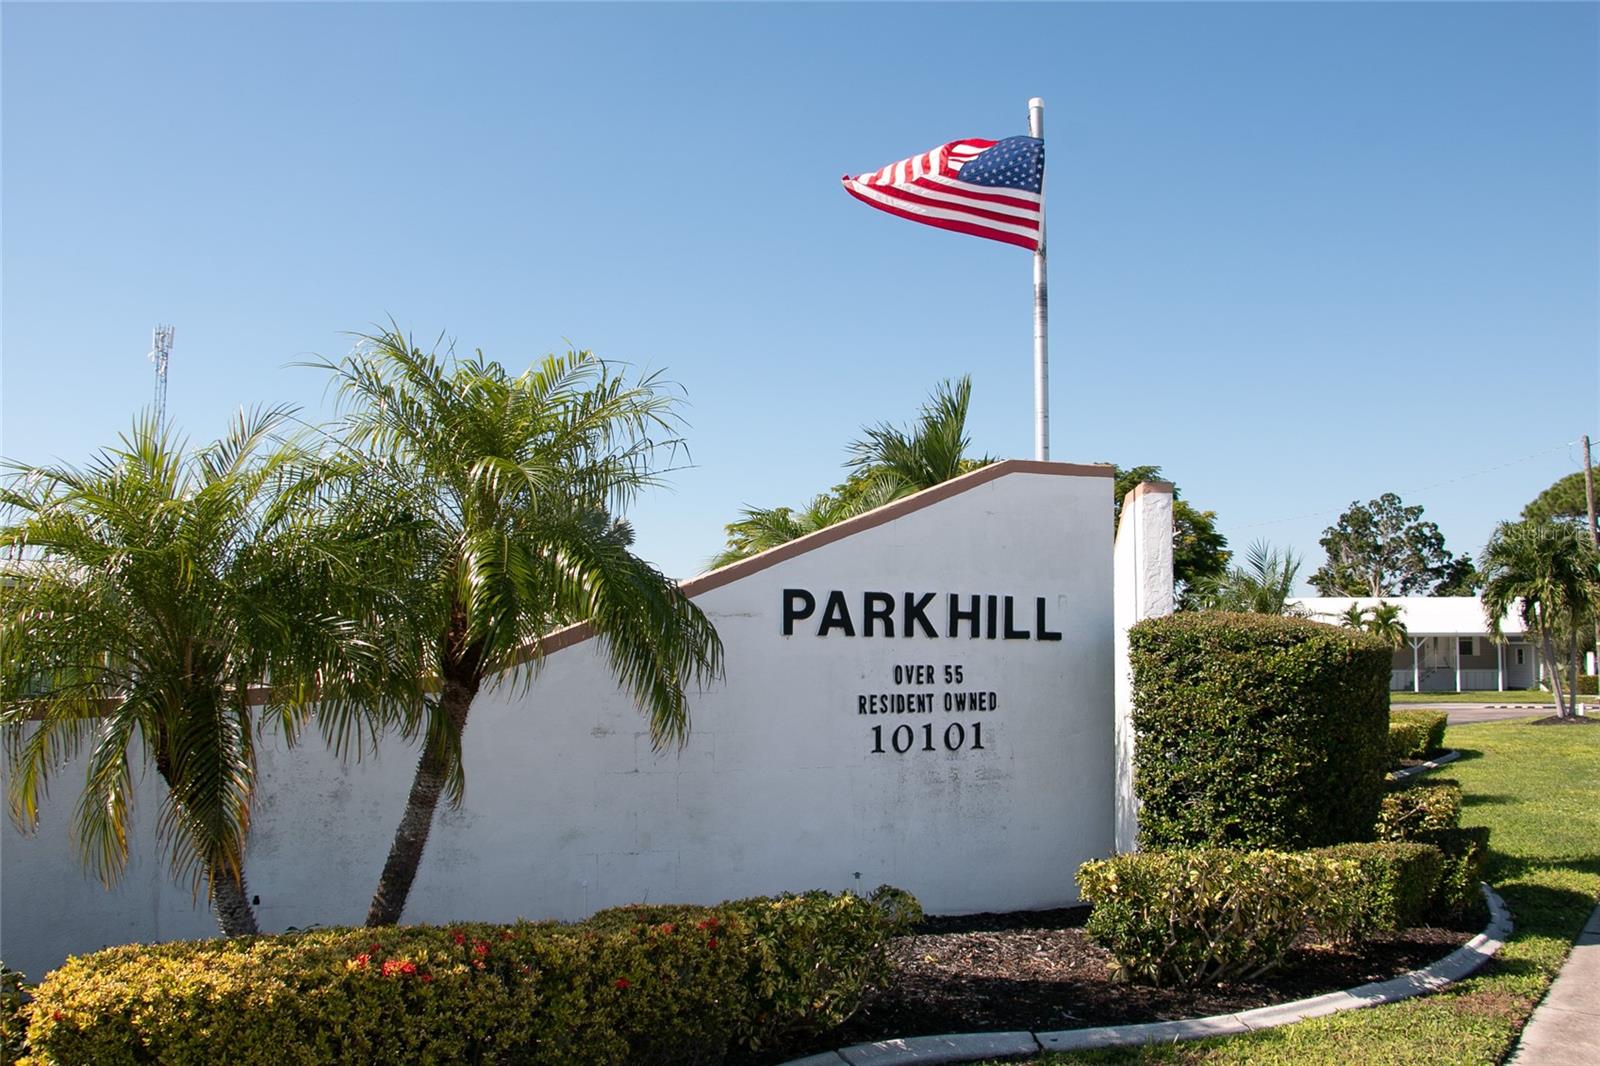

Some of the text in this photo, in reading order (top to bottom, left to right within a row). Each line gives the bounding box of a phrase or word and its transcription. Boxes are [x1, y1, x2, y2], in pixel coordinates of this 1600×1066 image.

[782, 588, 1063, 642] PARKHILL
[894, 664, 964, 686] OVER 55
[858, 691, 997, 715] RESIDENT OWNED
[870, 721, 985, 755] 10101
